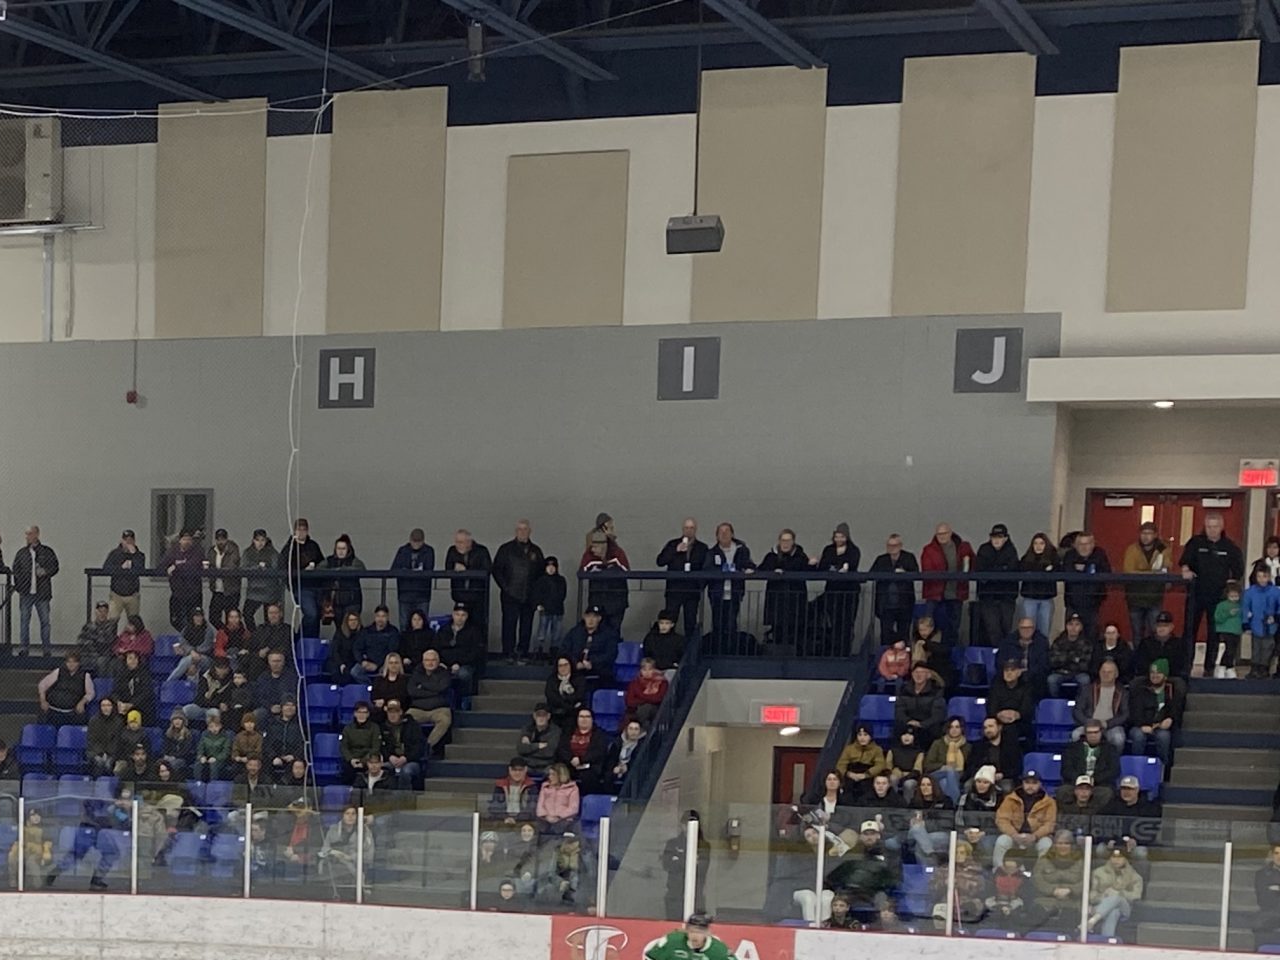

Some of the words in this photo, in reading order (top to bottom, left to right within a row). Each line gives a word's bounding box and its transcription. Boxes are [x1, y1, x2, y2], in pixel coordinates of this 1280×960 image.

[328, 356, 365, 401] H
[683, 346, 695, 392] I
[970, 335, 1007, 385] J
